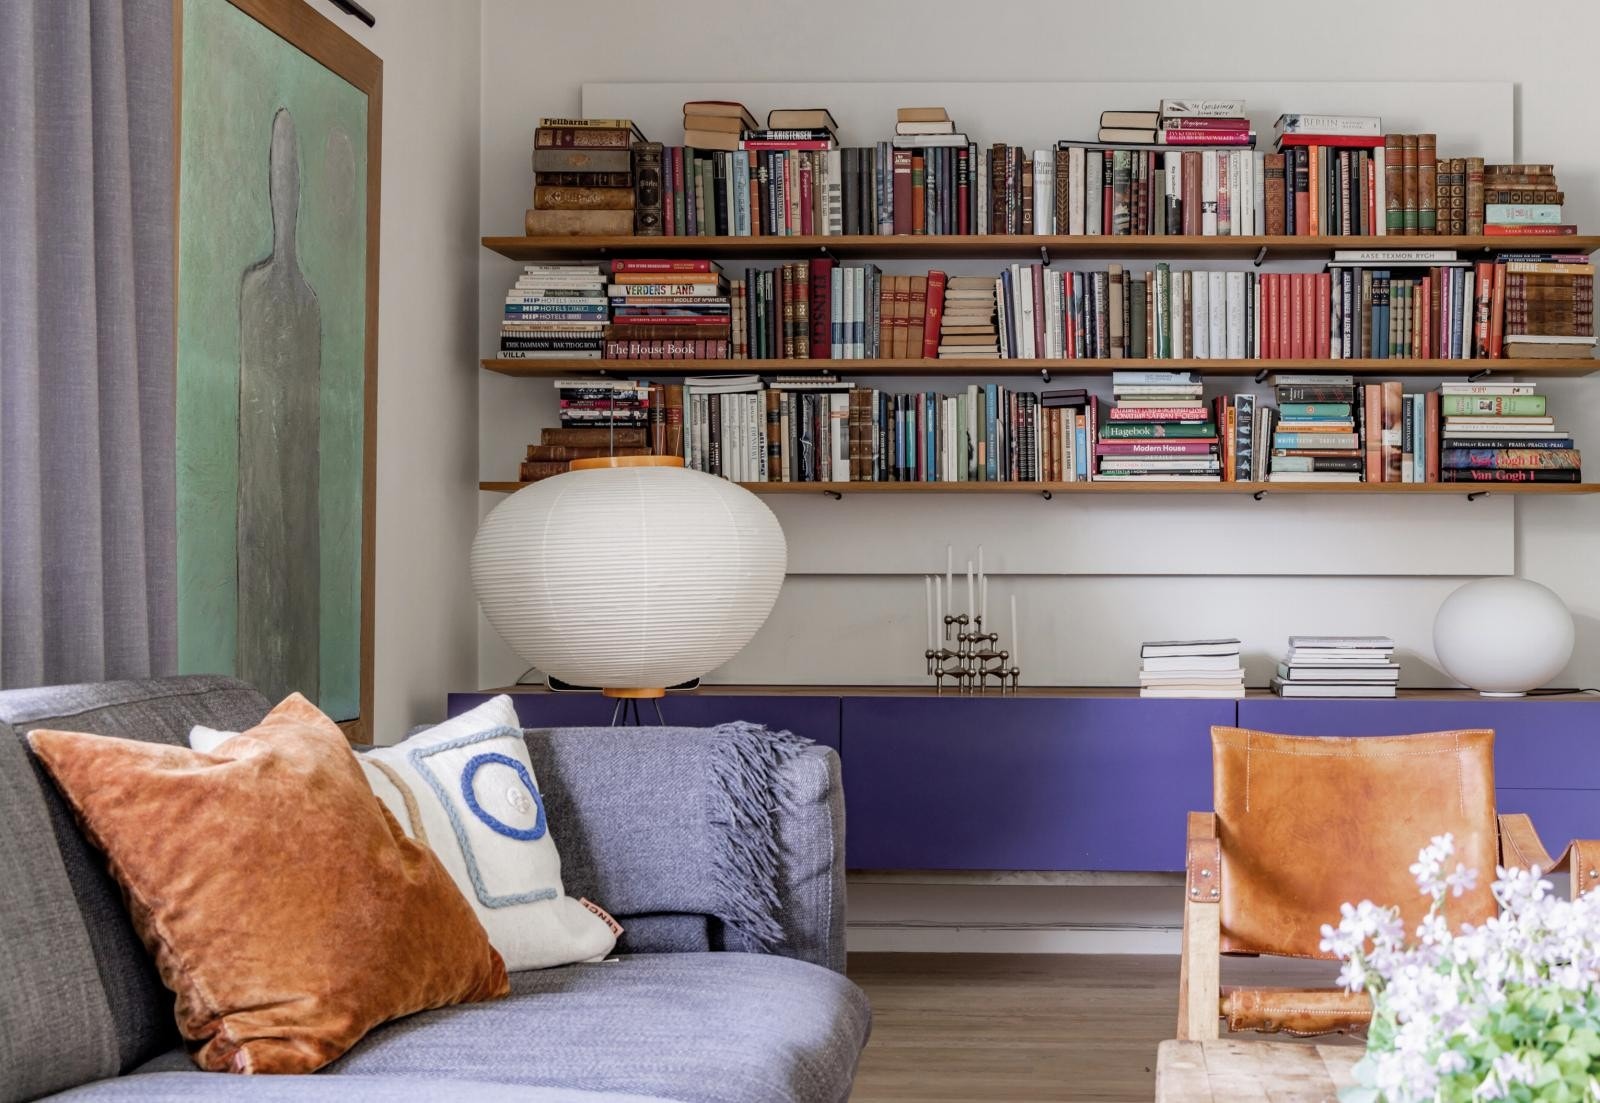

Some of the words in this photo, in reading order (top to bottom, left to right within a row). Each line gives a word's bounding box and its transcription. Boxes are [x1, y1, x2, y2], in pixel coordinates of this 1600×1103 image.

[543, 118, 589, 127] Fjellbarna
[625, 285, 667, 295] VERDENS
[670, 285, 695, 295] LAND
[608, 344, 629, 354] The
[631, 344, 665, 354] House
[667, 344, 695, 354] Book
[1495, 397, 1503, 415] MAO
[1110, 427, 1151, 437] Hagebok
[1470, 455, 1491, 466] Van
[1495, 455, 1525, 469] Gogh
[1528, 455, 1539, 466] II
[1471, 470, 1493, 480] Van
[1495, 470, 1527, 482] Gogh
[1529, 470, 1535, 480] I
